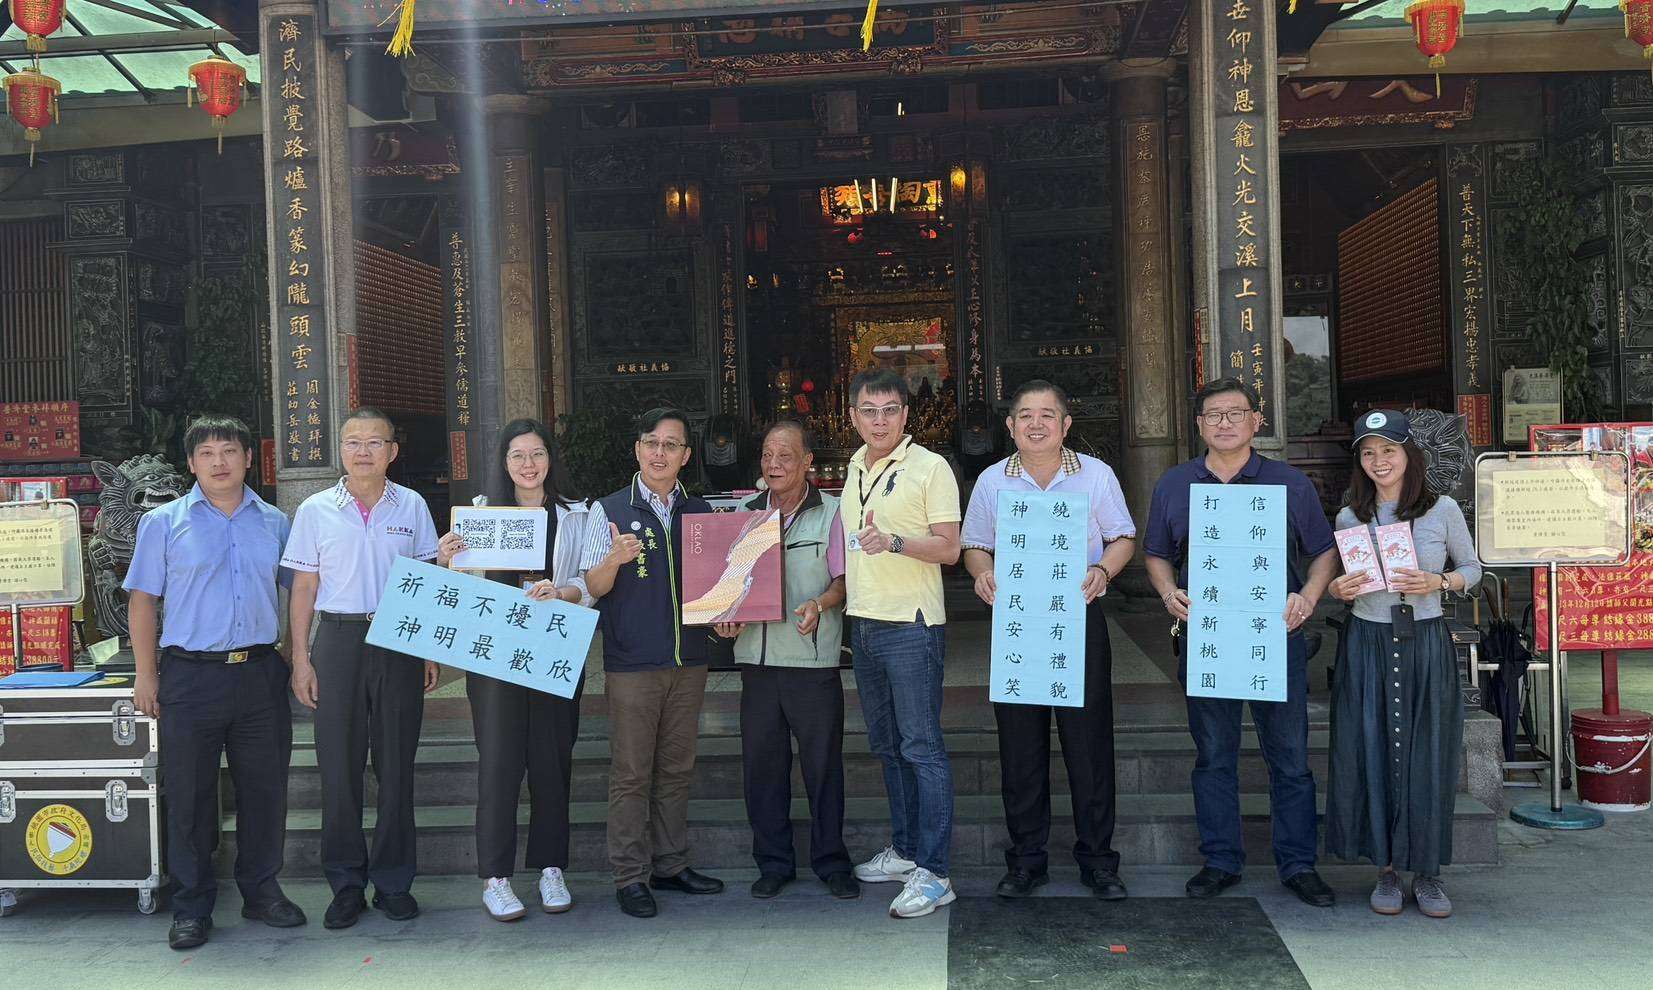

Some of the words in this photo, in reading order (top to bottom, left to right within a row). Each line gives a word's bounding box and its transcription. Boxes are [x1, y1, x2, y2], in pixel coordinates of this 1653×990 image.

[397, 572, 568, 639] 祈福不擾民
[694, 523, 703, 554] OKLAO
[1004, 500, 1028, 697] 神明居民安心笑
[1048, 501, 1071, 699] 繞境莊嚴有禮貌
[1200, 495, 1221, 689] 打造永續新桃園
[1249, 496, 1269, 692] 信仰與安寧同行
[394, 615, 573, 683] 神明最歡欣
